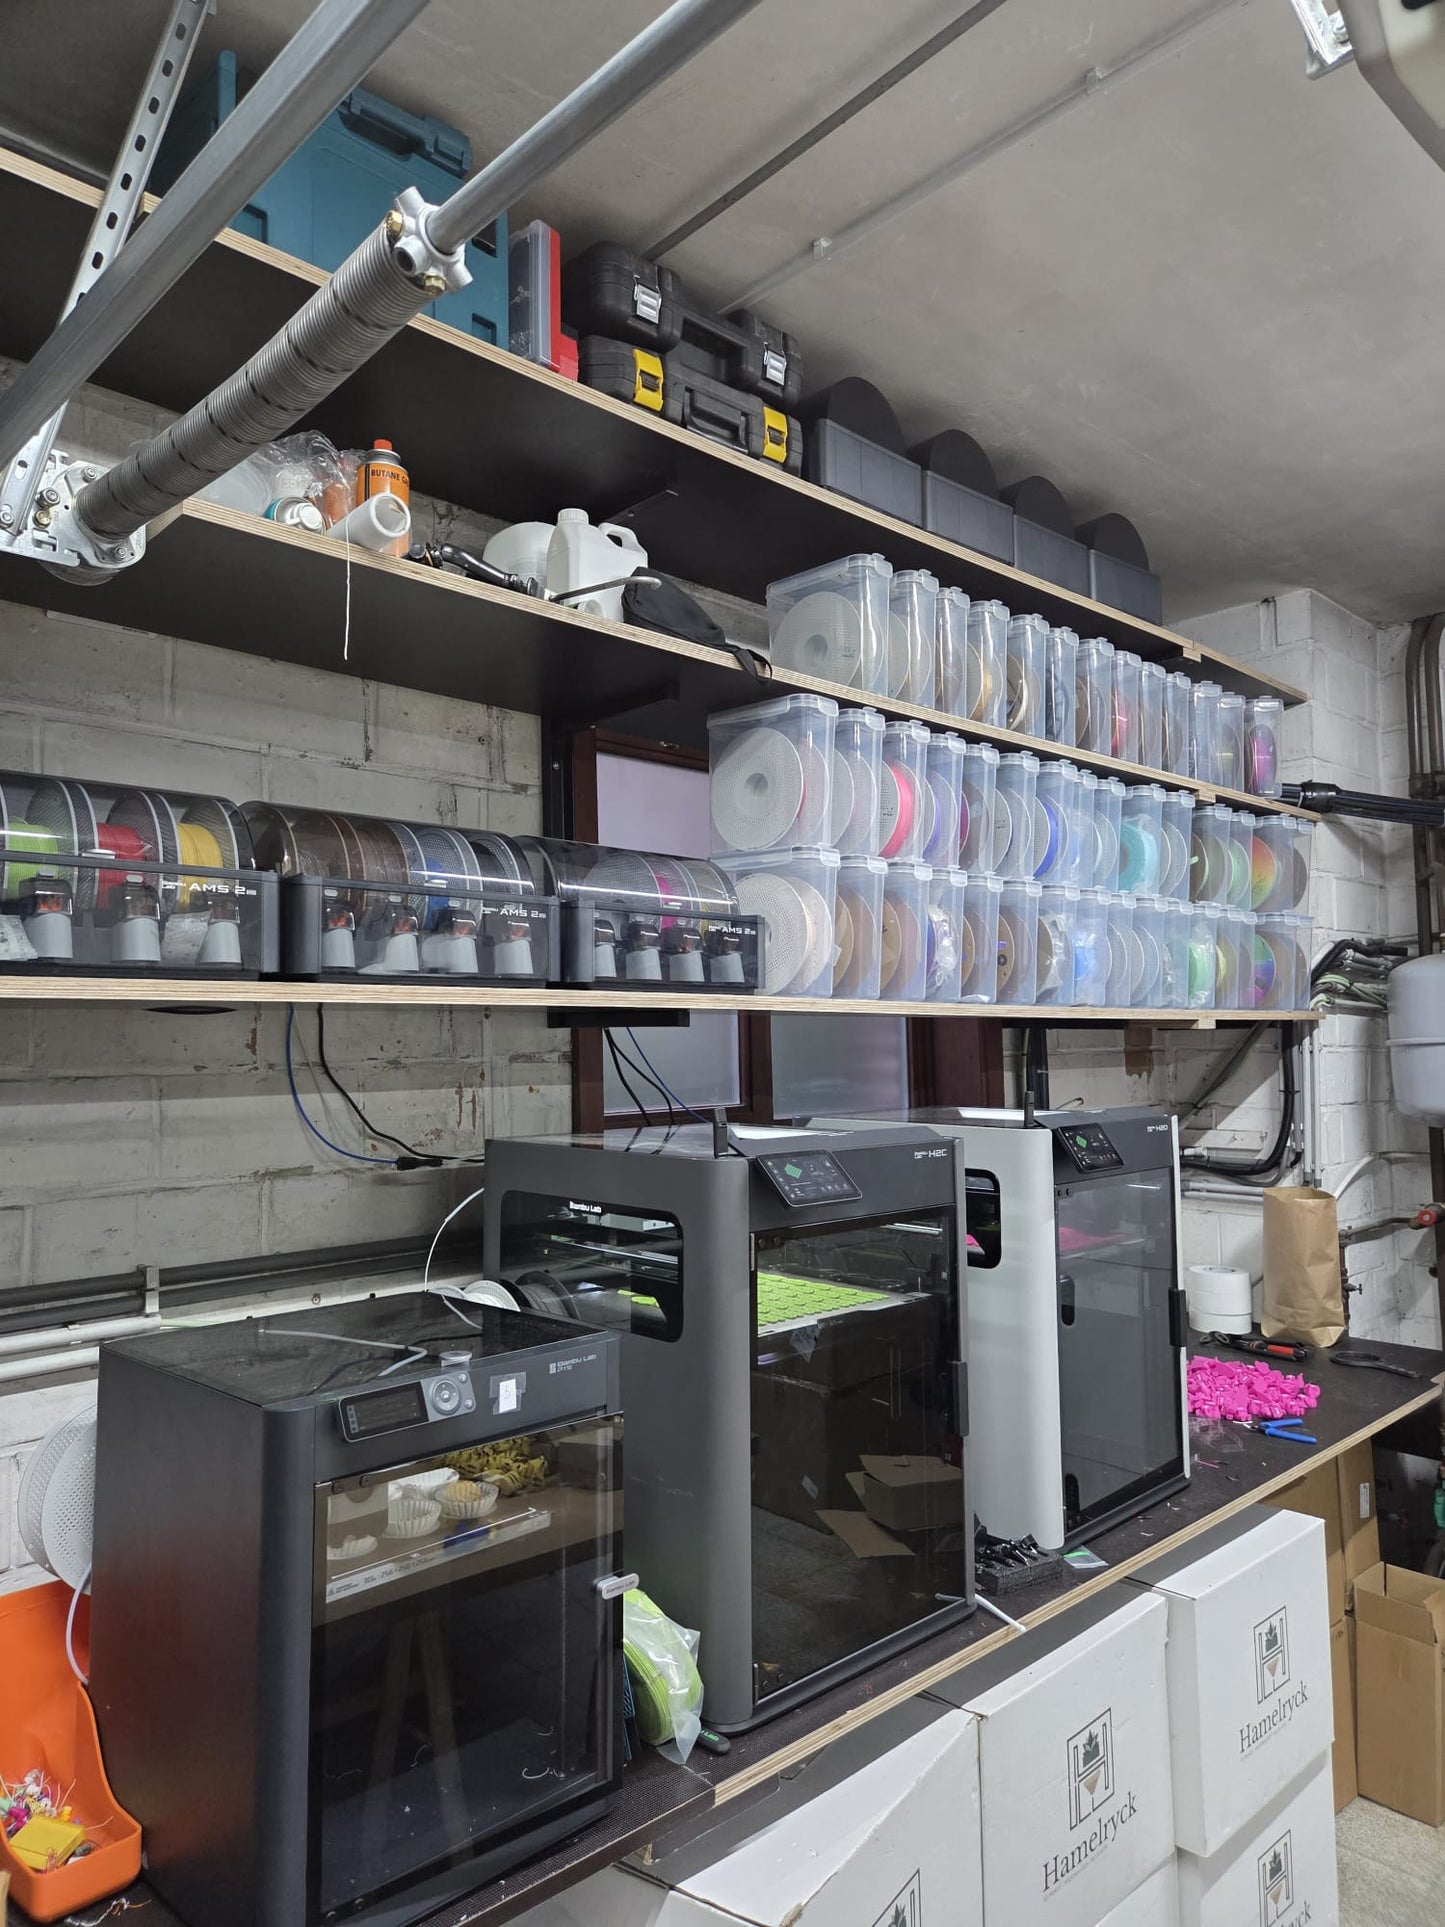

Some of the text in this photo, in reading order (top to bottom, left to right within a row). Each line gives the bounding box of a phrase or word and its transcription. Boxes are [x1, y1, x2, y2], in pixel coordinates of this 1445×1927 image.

[371, 469, 401, 481] BUTANE
[189, 883, 229, 894] AMS
[500, 908, 528, 917] AMS
[722, 926, 742, 934] AMS
[928, 1148, 947, 1158] H2C
[1239, 1680, 1309, 1754] Hamelryck
[1042, 1790, 1138, 1893] Hamelryck
